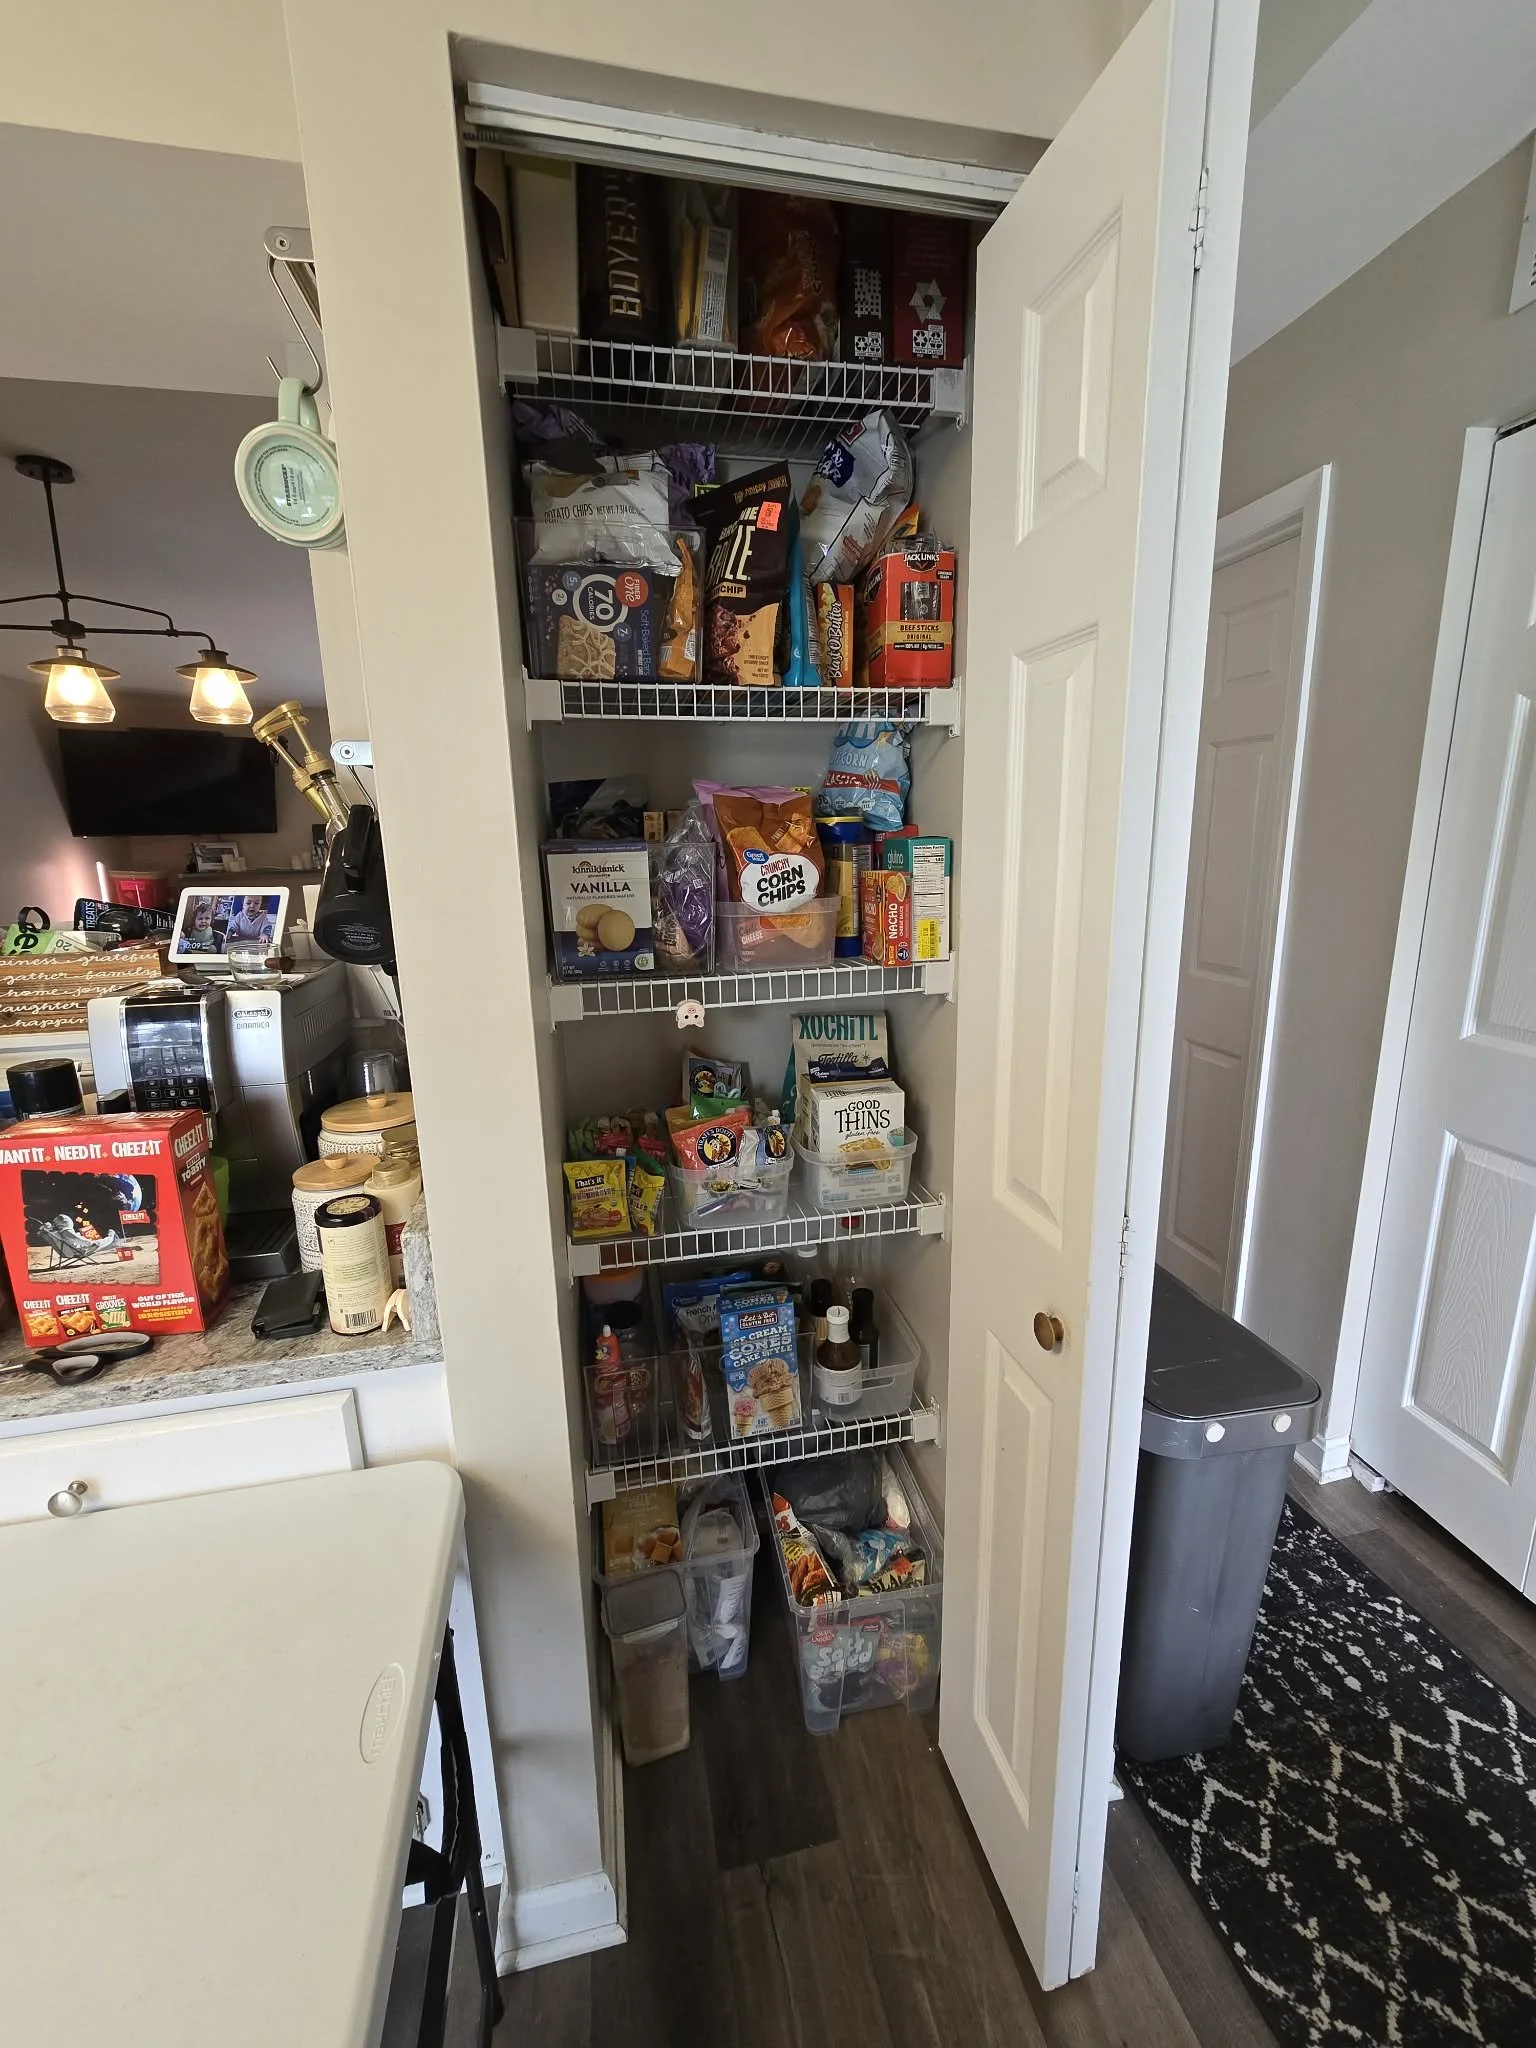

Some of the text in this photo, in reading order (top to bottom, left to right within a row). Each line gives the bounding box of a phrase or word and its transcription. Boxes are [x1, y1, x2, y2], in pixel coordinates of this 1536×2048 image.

[605, 163, 644, 320] BOYER'
[281, 464, 292, 507] STARBUCKS
[544, 507, 571, 524] POTATO
[572, 504, 594, 517] CHIPS
[904, 553, 921, 562] JACK
[720, 585, 743, 594] CHIP
[587, 586, 595, 620] CALORIES
[595, 588, 614, 621] 70
[825, 601, 843, 637] Butter
[900, 624, 940, 632] BEEF STICKS
[640, 609, 651, 676] Soft-Baked Bars
[825, 650, 842, 679] Blast
[825, 772, 862, 787] LASSIC
[760, 857, 790, 876] CRUNCHY
[887, 850, 904, 870] glutino
[572, 863, 625, 874] kinnikinnick
[757, 864, 803, 892] CORN
[570, 881, 631, 894] VANILLA
[757, 879, 806, 907] CHIPS
[86, 901, 96, 929] TREATS
[889, 903, 898, 940] NACHO
[738, 923, 757, 937] Chili
[741, 930, 763, 945] CHEESE
[78, 953, 159, 967] grateful
[5, 966, 160, 986] gather family
[5, 989, 60, 998] home
[13, 1018, 88, 1030] happin
[236, 1021, 270, 1030] DINAMICA
[818, 1051, 860, 1064] Tortilla
[848, 1099, 880, 1111] GOOD
[834, 1109, 890, 1133] THINS
[715, 1128, 735, 1140] BOOTY
[845, 1129, 880, 1140] gluten free
[31, 1147, 45, 1163] IT
[54, 1145, 89, 1162] NEED
[89, 1143, 102, 1160] IT
[576, 1178, 596, 1189] That's
[95, 1300, 127, 1311] GROOVES
[132, 1301, 161, 1309] WORLD
[734, 1295, 775, 1308] CONES
[686, 1305, 712, 1318] French
[742, 1320, 763, 1328] GLUTEN
[730, 1325, 788, 1350] ICE CREAM
[728, 1333, 792, 1361] CONES
[733, 1352, 760, 1368] CAKE
